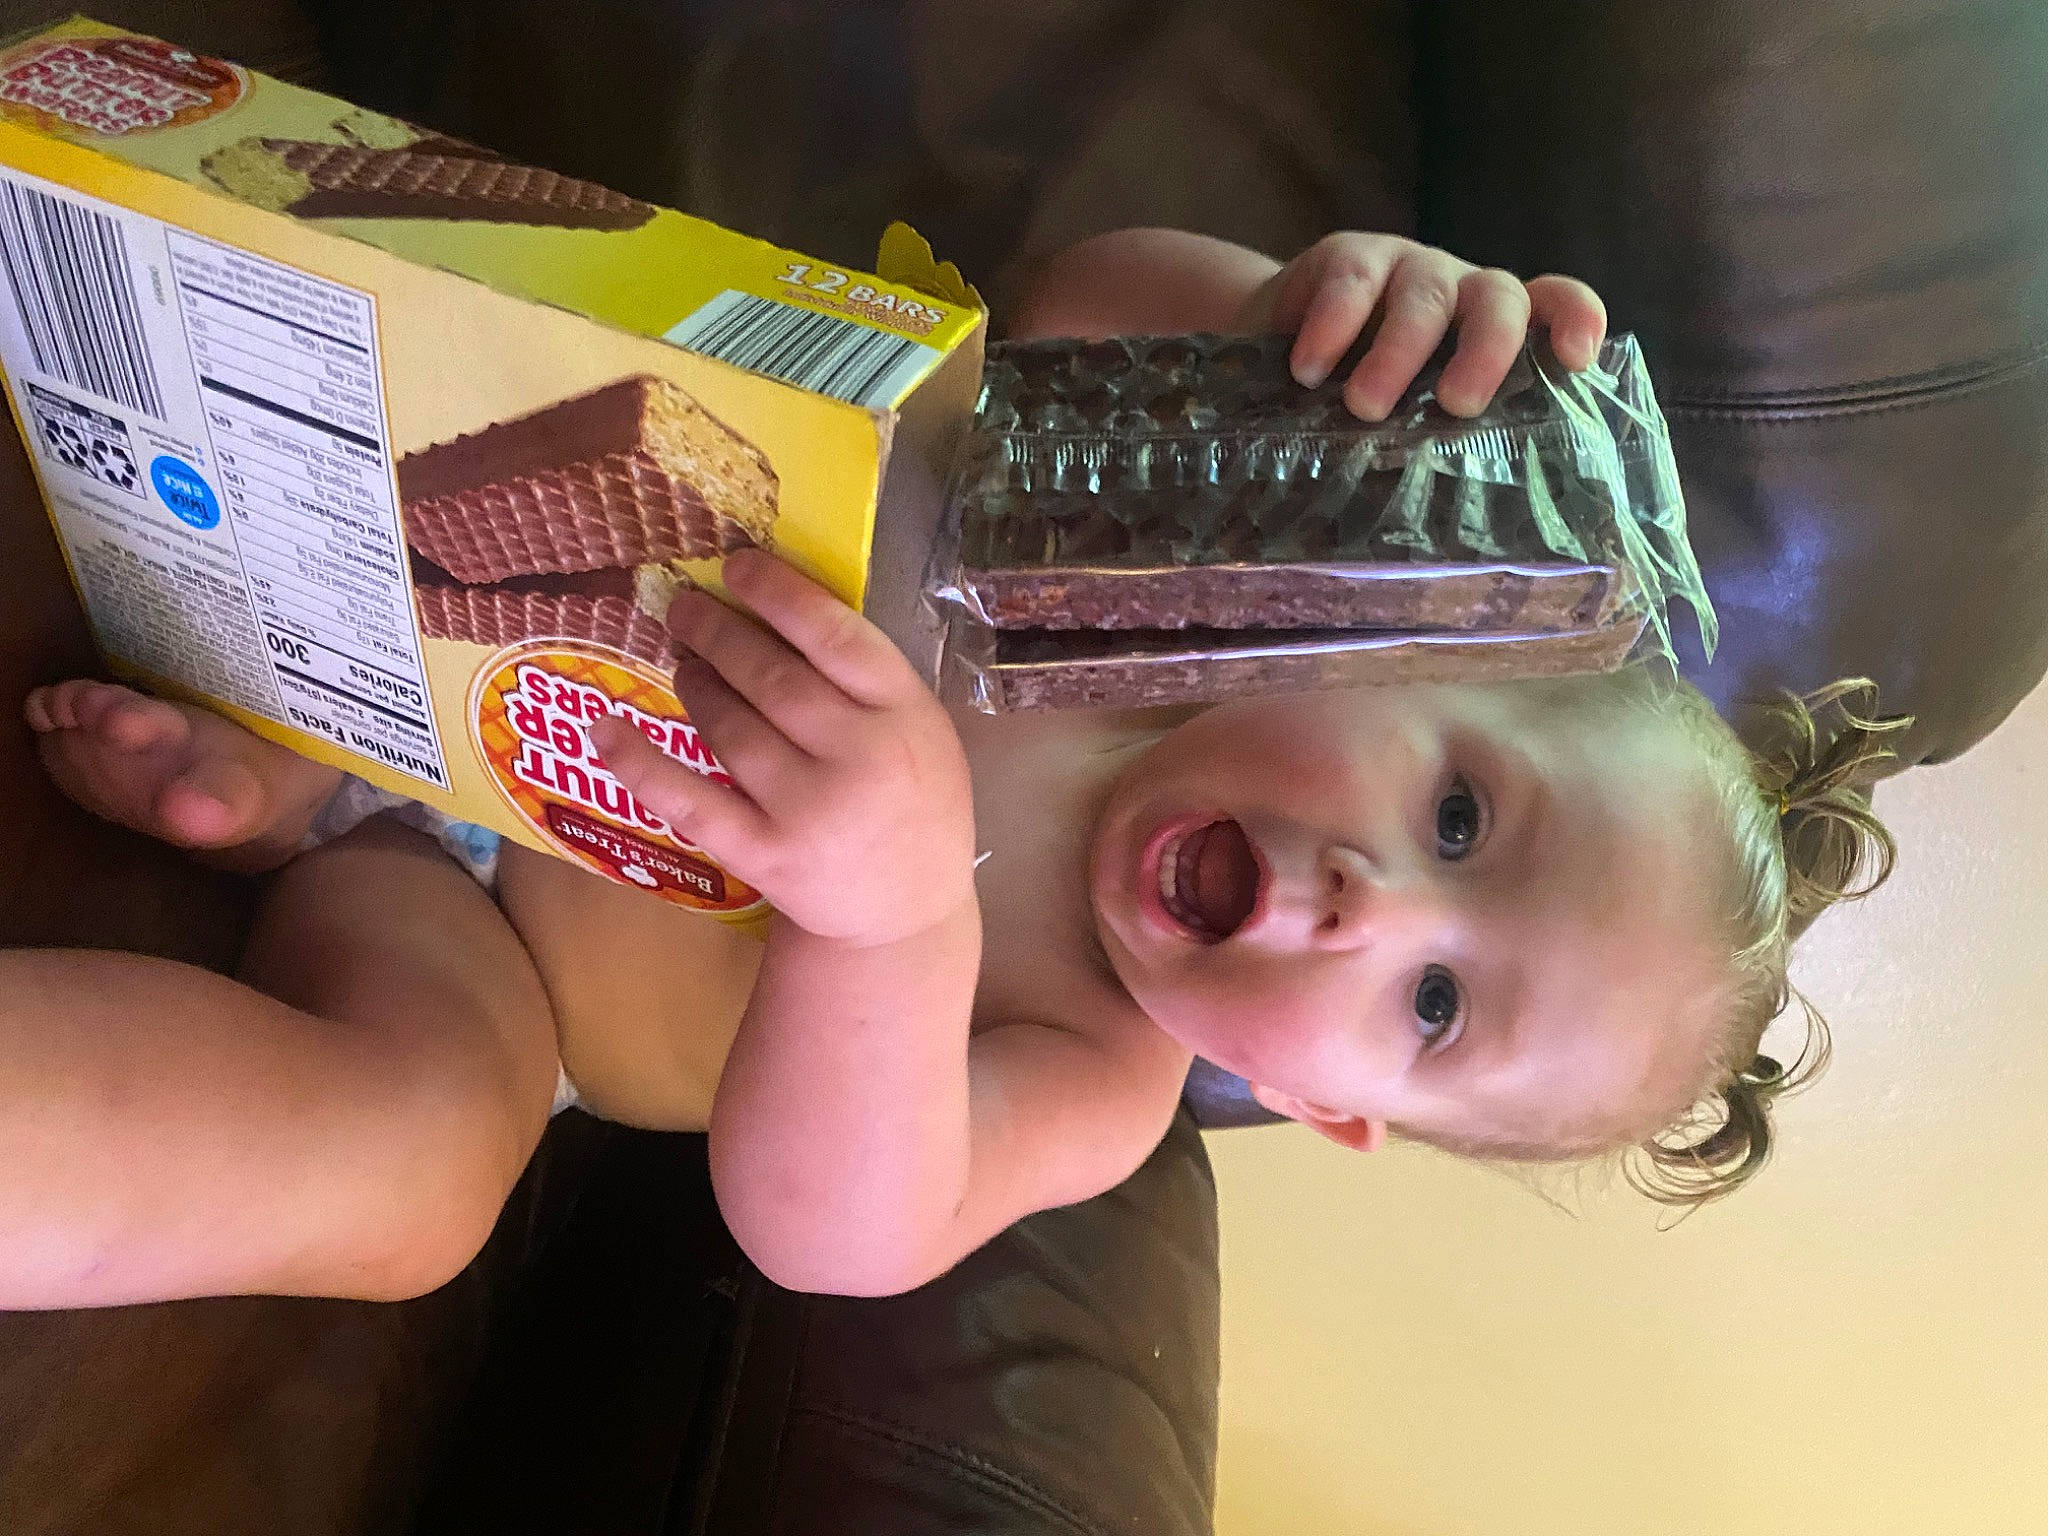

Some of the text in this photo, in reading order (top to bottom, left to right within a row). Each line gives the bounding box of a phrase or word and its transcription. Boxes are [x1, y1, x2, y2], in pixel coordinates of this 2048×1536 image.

[775, 257, 850, 297] 12
[845, 281, 948, 326] BARS
[338, 391, 376, 416] Calcium
[343, 444, 382, 468] Protein
[322, 471, 353, 495] Sugars
[353, 485, 376, 504] Total
[299, 498, 366, 534] Carbohydrate
[366, 525, 393, 545] Total
[359, 540, 396, 563] Sodium
[343, 550, 399, 581] Cholesterol
[249, 575, 271, 591] 45%
[371, 638, 388, 652] Fat
[388, 645, 414, 664] Total
[264, 629, 423, 708] Calories 300
[322, 693, 356, 716] wafers
[391, 698, 426, 720] Amount
[372, 714, 393, 731] size
[287, 705, 442, 783] Nutrition Facts
[394, 722, 433, 748] Serving
[562, 821, 712, 894] Baker's Treat
